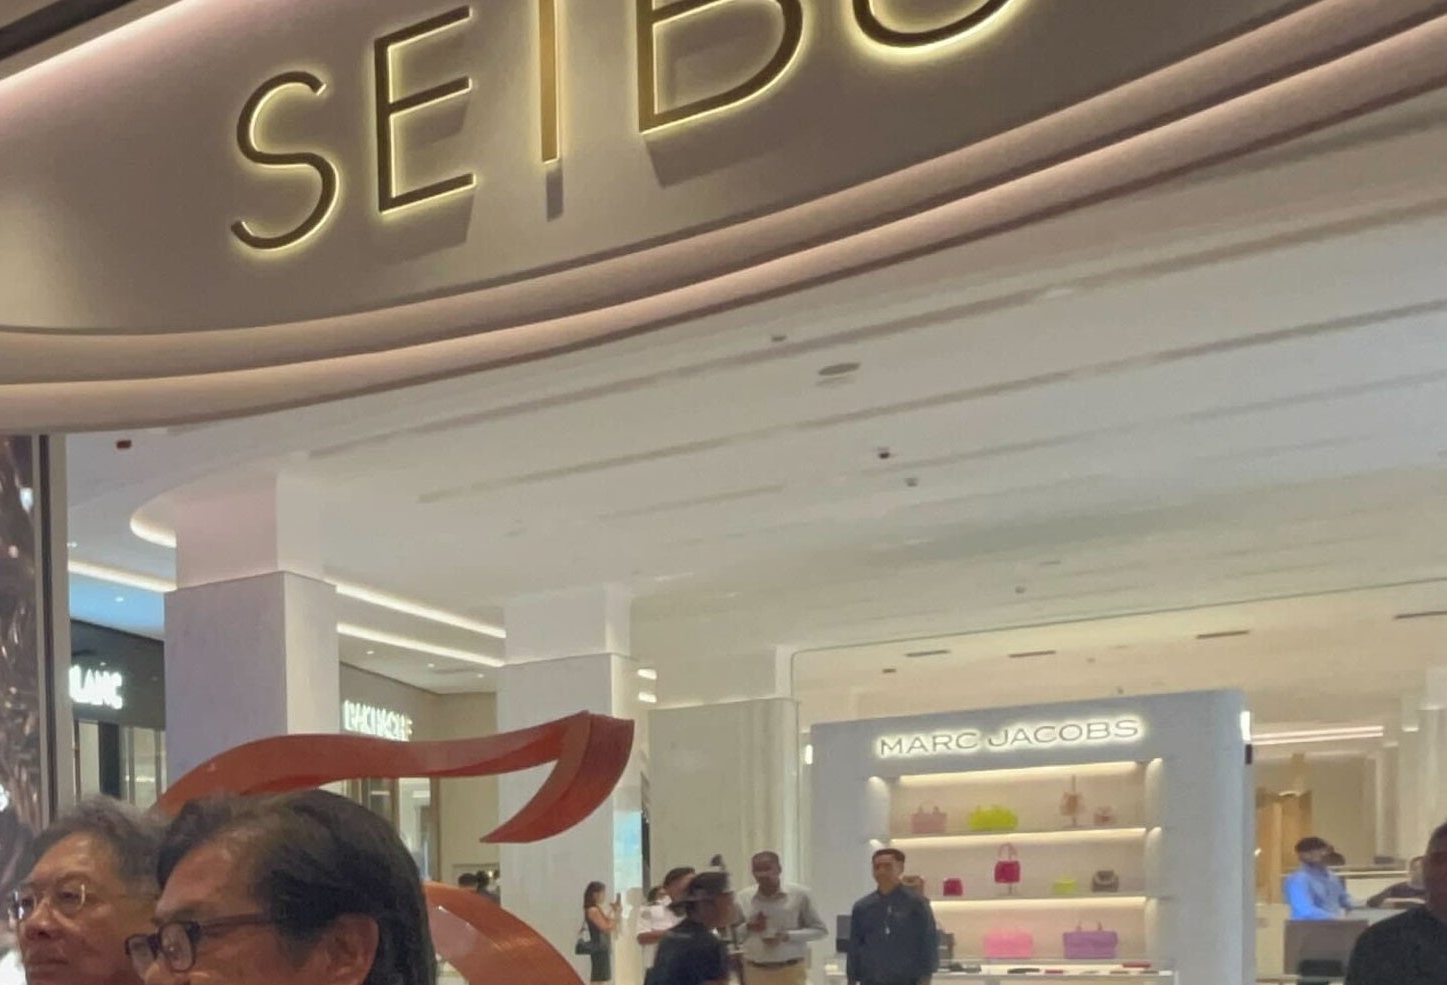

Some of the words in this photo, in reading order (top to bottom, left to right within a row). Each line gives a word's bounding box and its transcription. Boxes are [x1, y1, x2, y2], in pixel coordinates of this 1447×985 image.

[230, 0, 1015, 252] SEIB
[879, 730, 979, 756] MARC
[987, 717, 1140, 748] JACOBS
